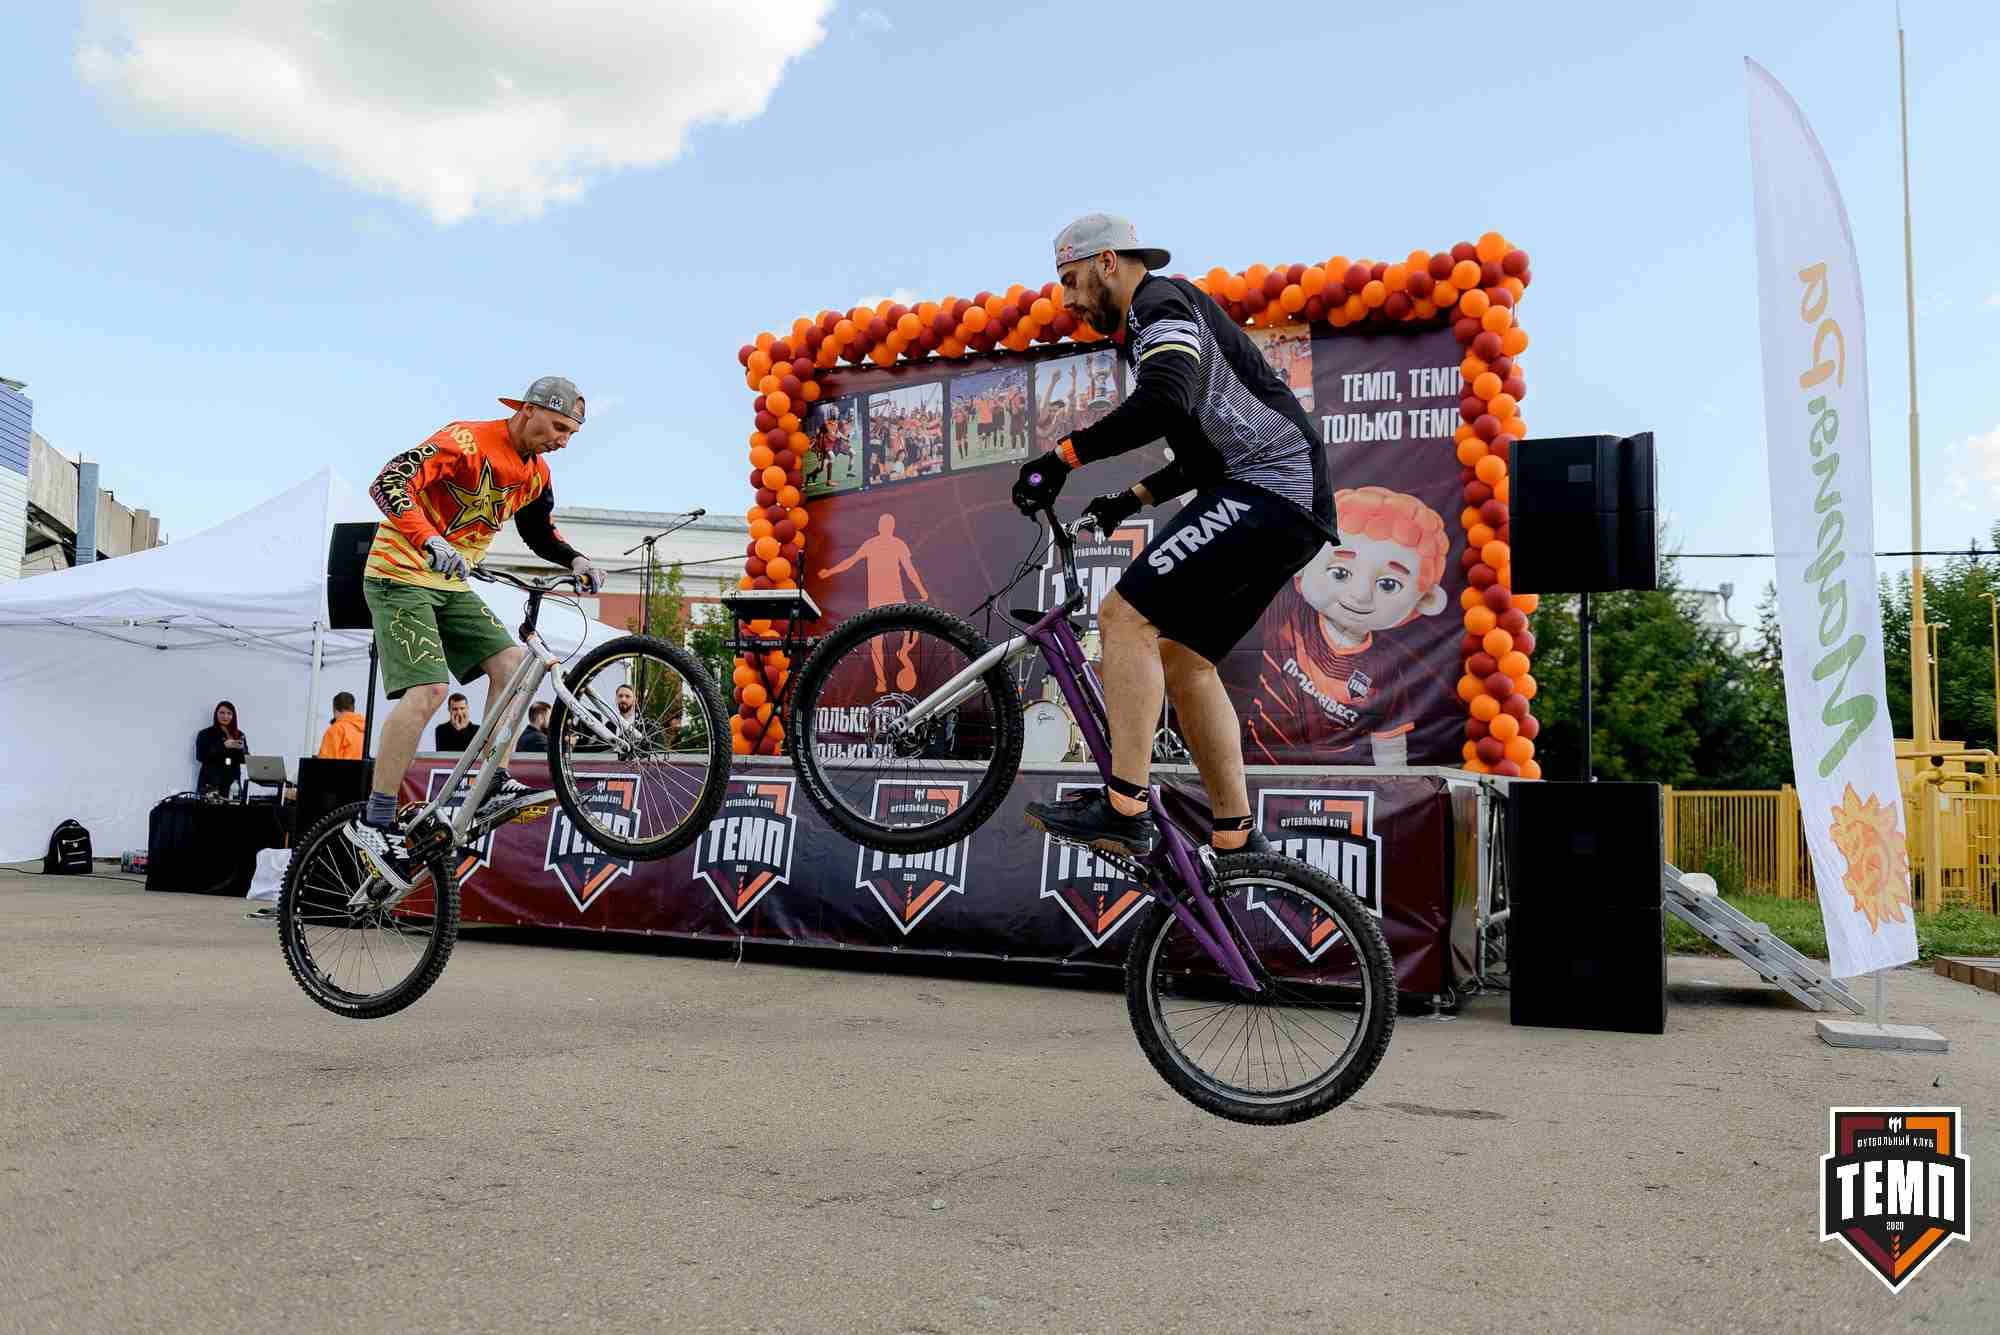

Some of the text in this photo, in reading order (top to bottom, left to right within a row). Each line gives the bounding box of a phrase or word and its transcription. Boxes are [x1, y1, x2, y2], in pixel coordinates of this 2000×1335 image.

[1341, 370, 1402, 403] ТЕМП,
[1321, 410, 1403, 444] ТОЛЬКО
[1148, 497, 1253, 575] STRAVA
[1052, 566, 1123, 616] ТЕМ
[708, 816, 786, 868] ТЕМП
[1270, 838, 1368, 899] МП
